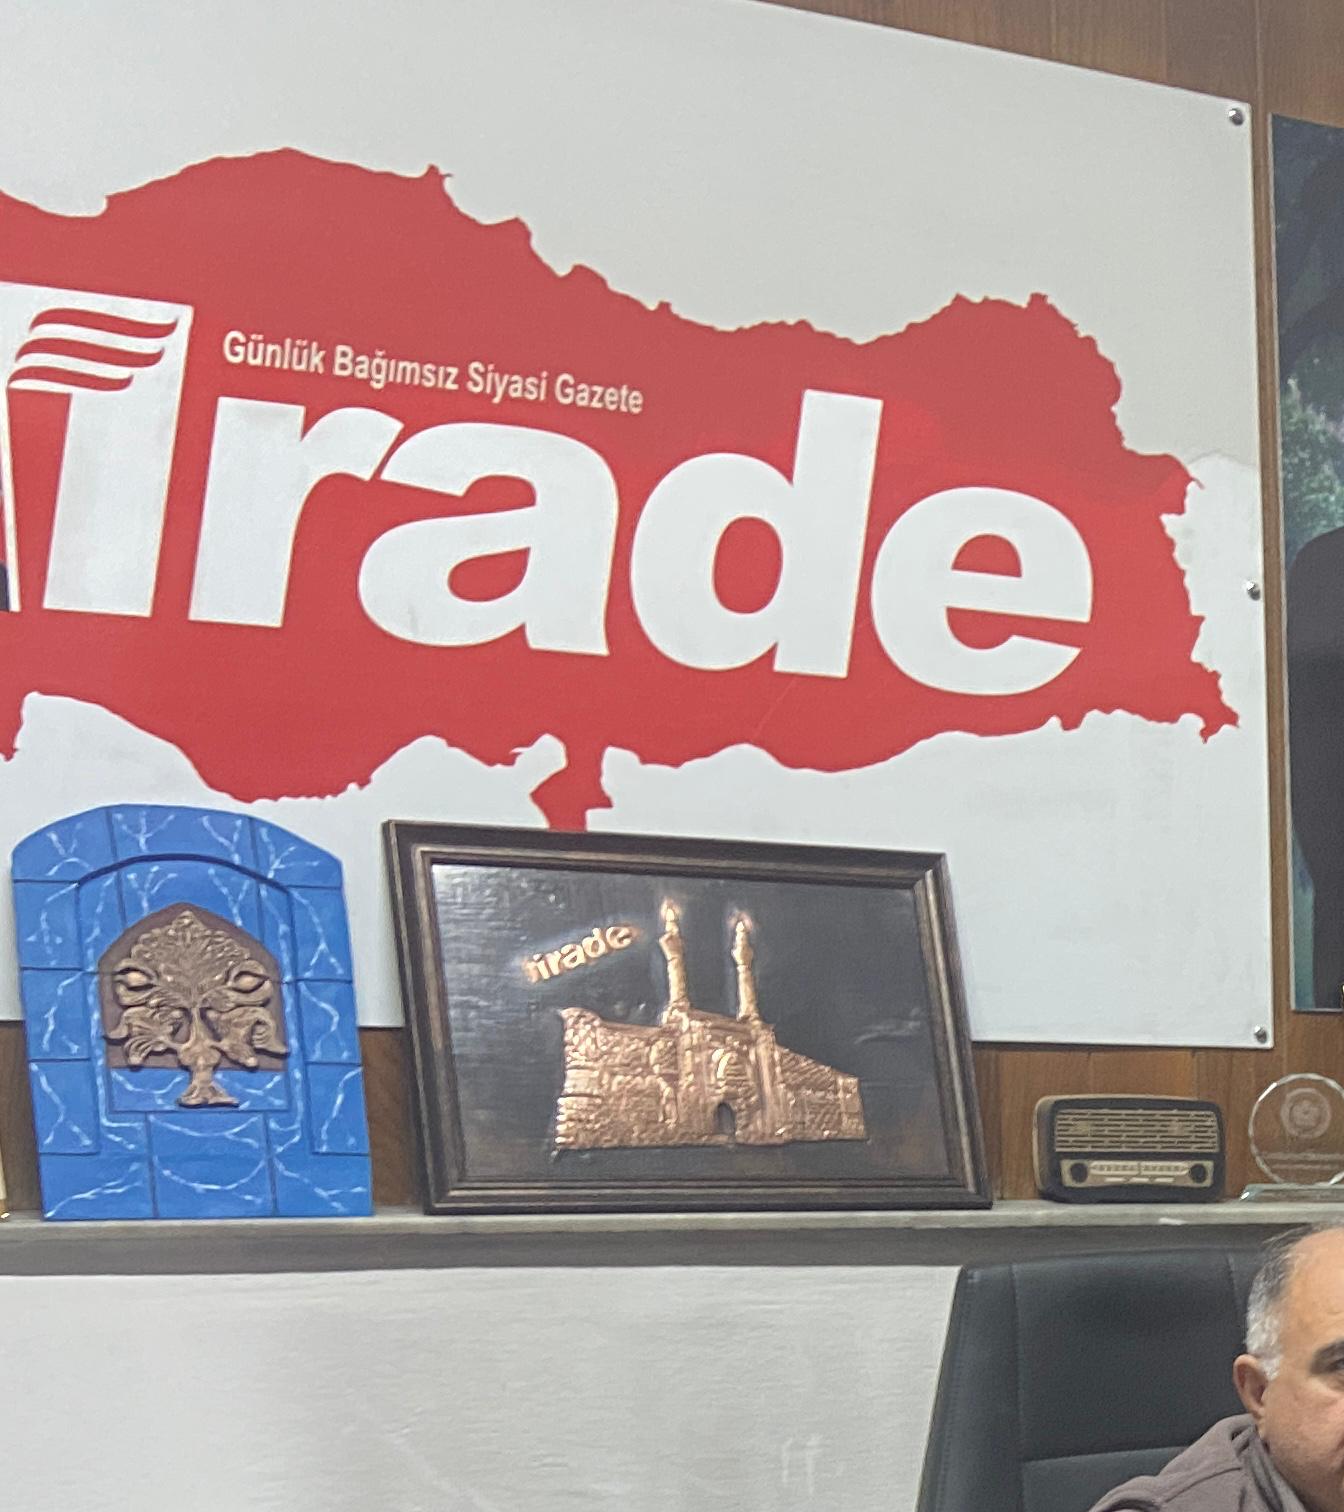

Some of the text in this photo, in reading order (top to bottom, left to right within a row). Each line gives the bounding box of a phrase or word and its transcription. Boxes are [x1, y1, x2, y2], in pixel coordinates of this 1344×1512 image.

[223, 329, 645, 415] Günlük Bağımsız Siyasi Gazete
